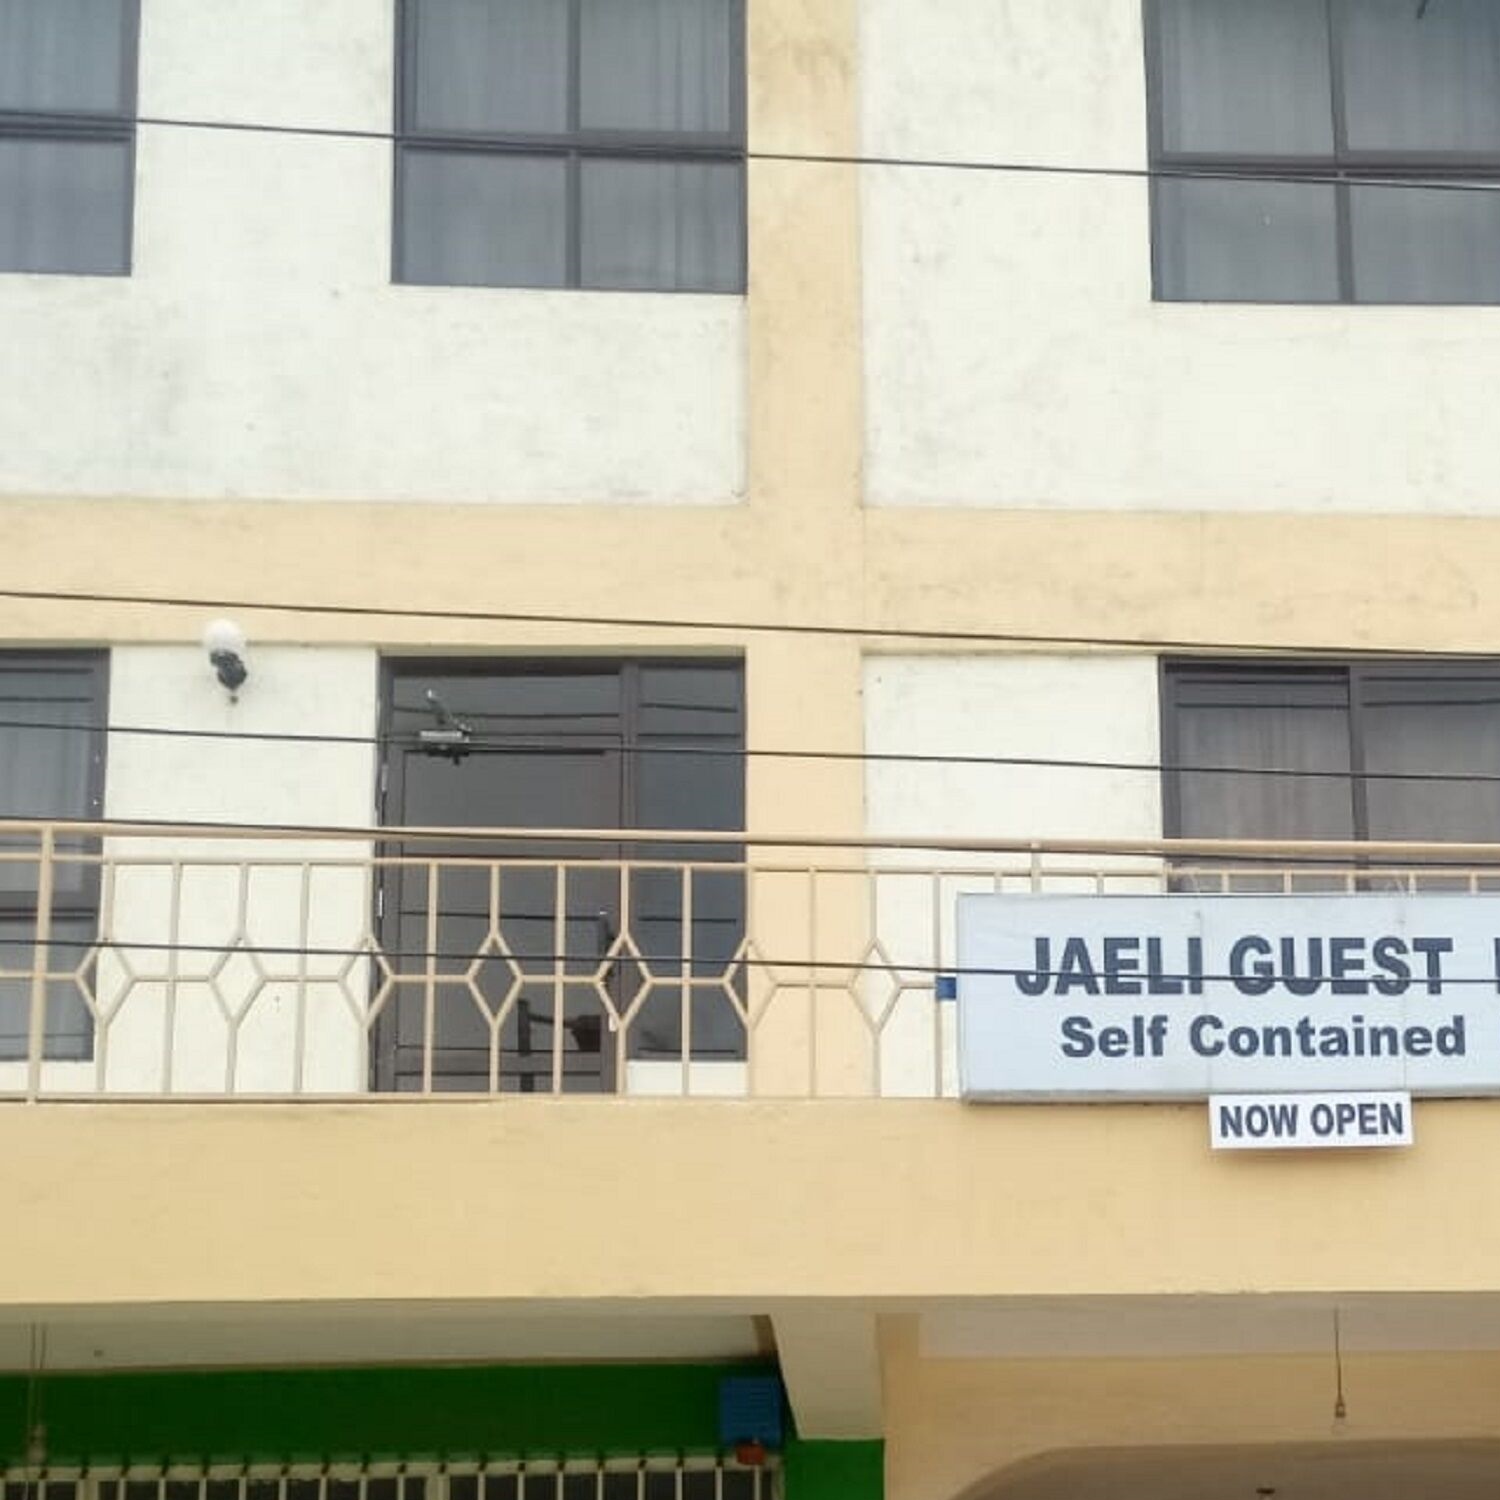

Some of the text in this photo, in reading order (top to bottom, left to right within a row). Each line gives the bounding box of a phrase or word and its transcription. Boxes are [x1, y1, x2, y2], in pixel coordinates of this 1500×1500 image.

[1015, 937, 1202, 996] JAELI
[1230, 937, 1453, 996] GUEST
[1061, 1014, 1167, 1058] Self
[1190, 1014, 1466, 1058] Contained
[1219, 1103, 1404, 1139] NOW OPEN
